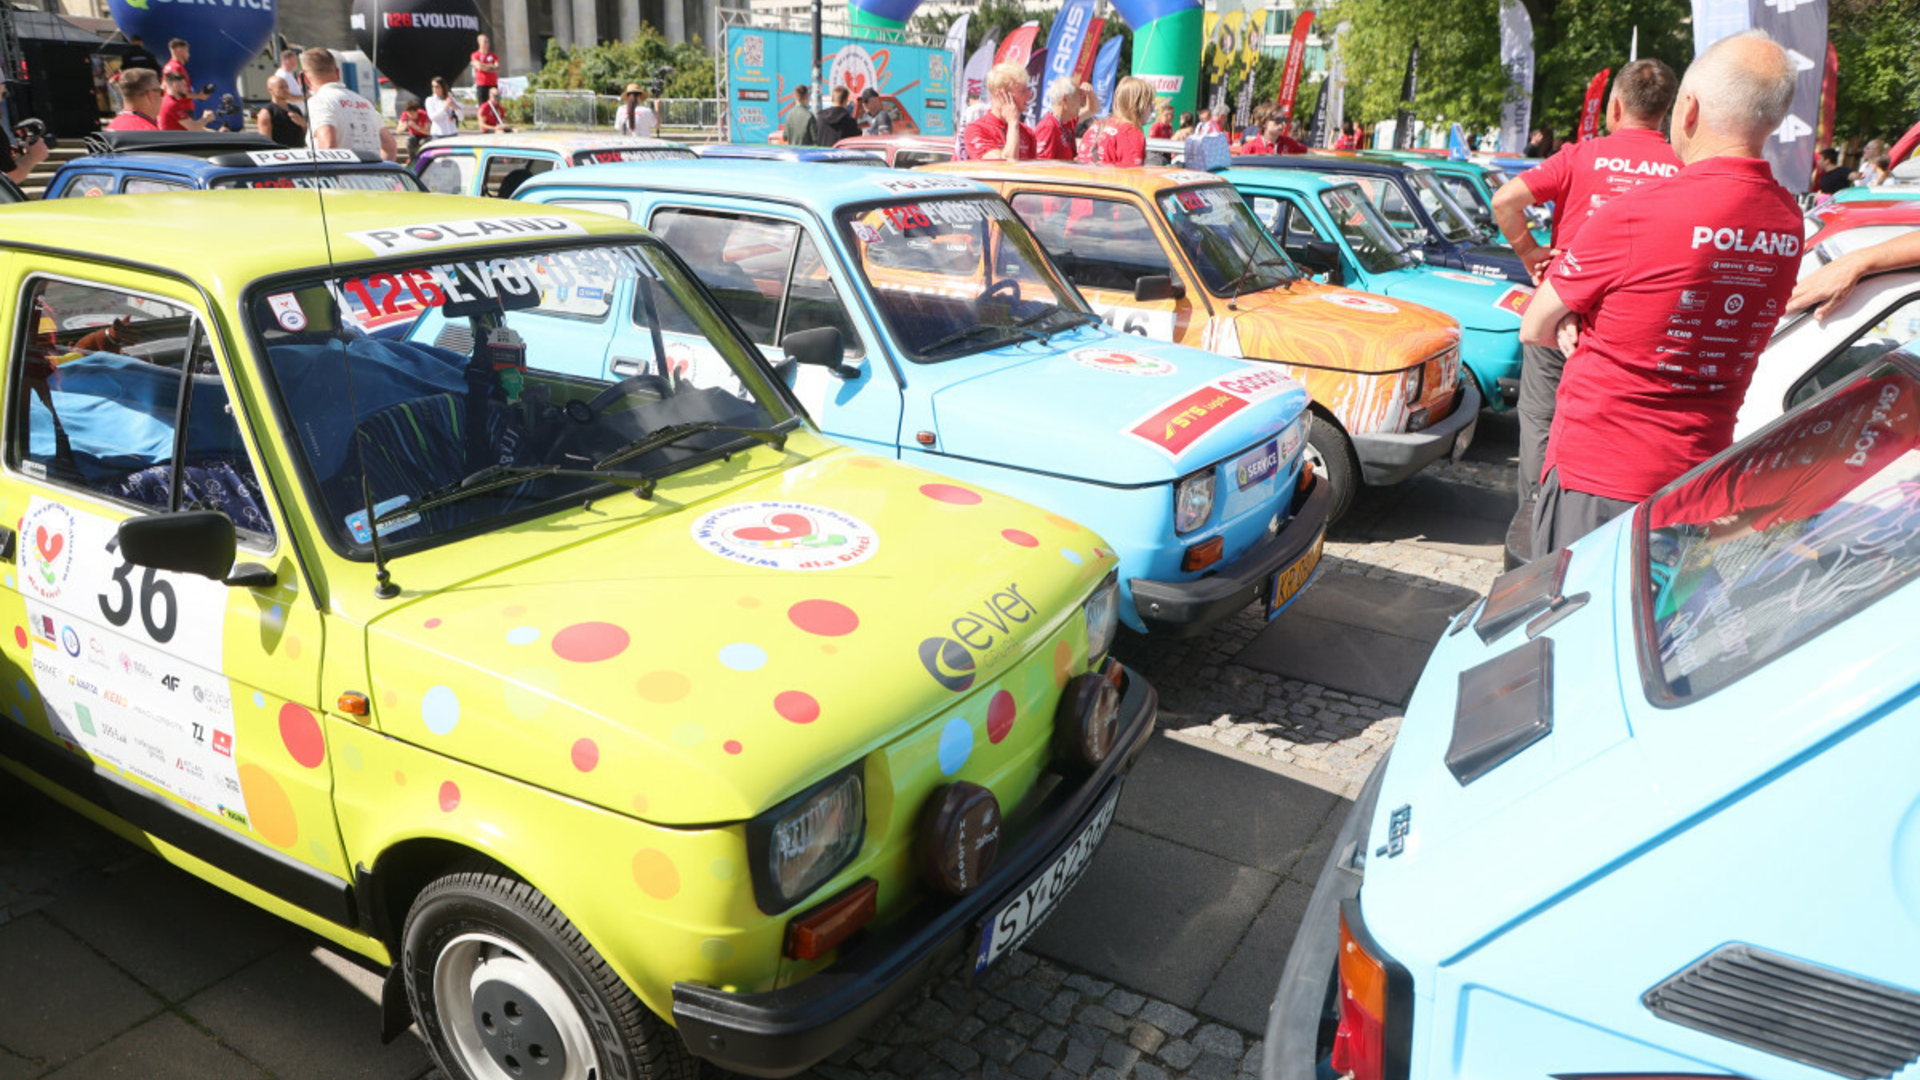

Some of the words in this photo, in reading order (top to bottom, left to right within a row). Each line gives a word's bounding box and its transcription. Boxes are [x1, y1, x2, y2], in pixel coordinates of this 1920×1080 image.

[257, 150, 353, 163] POLAND
[1594, 157, 1679, 177] POLAND
[366, 217, 569, 248] POLAND
[1691, 226, 1799, 257] POLAND
[1247, 452, 1278, 477] SERVICE
[97, 532, 178, 645] 36
[951, 582, 1038, 651] ever
